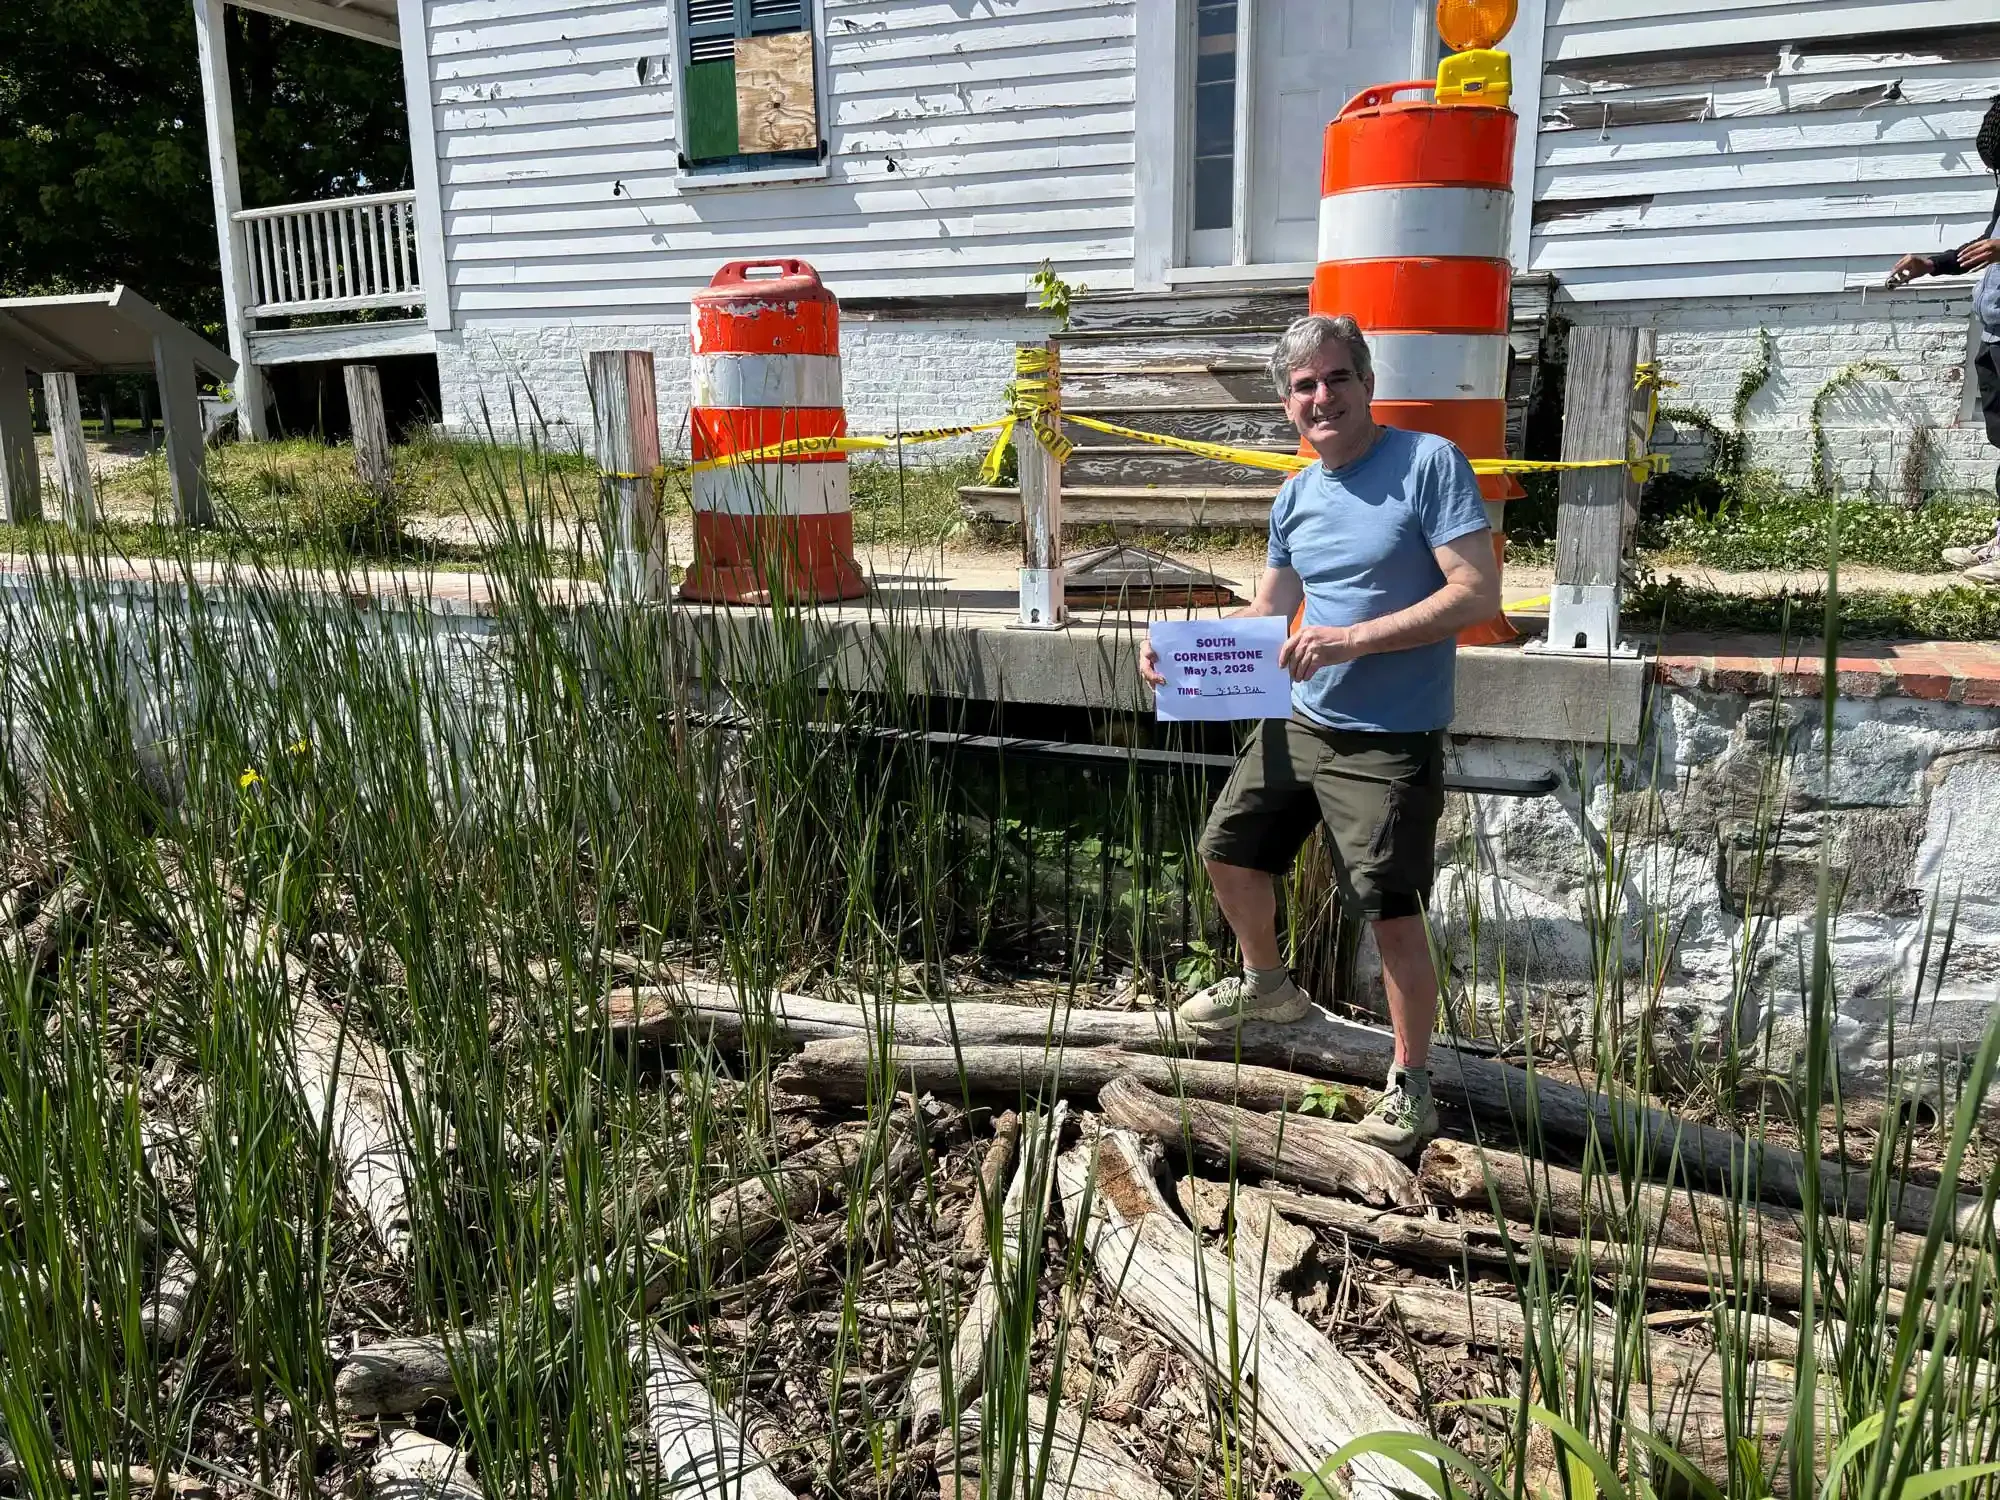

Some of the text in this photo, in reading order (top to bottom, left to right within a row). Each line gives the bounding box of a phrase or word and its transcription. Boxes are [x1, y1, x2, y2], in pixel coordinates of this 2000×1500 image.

[1196, 638, 1236, 648] SOUTH
[1174, 650, 1263, 662] CORNERSTONE
[1184, 664, 1254, 677] May 3, 2026
[1177, 687, 1203, 696] TIME:
